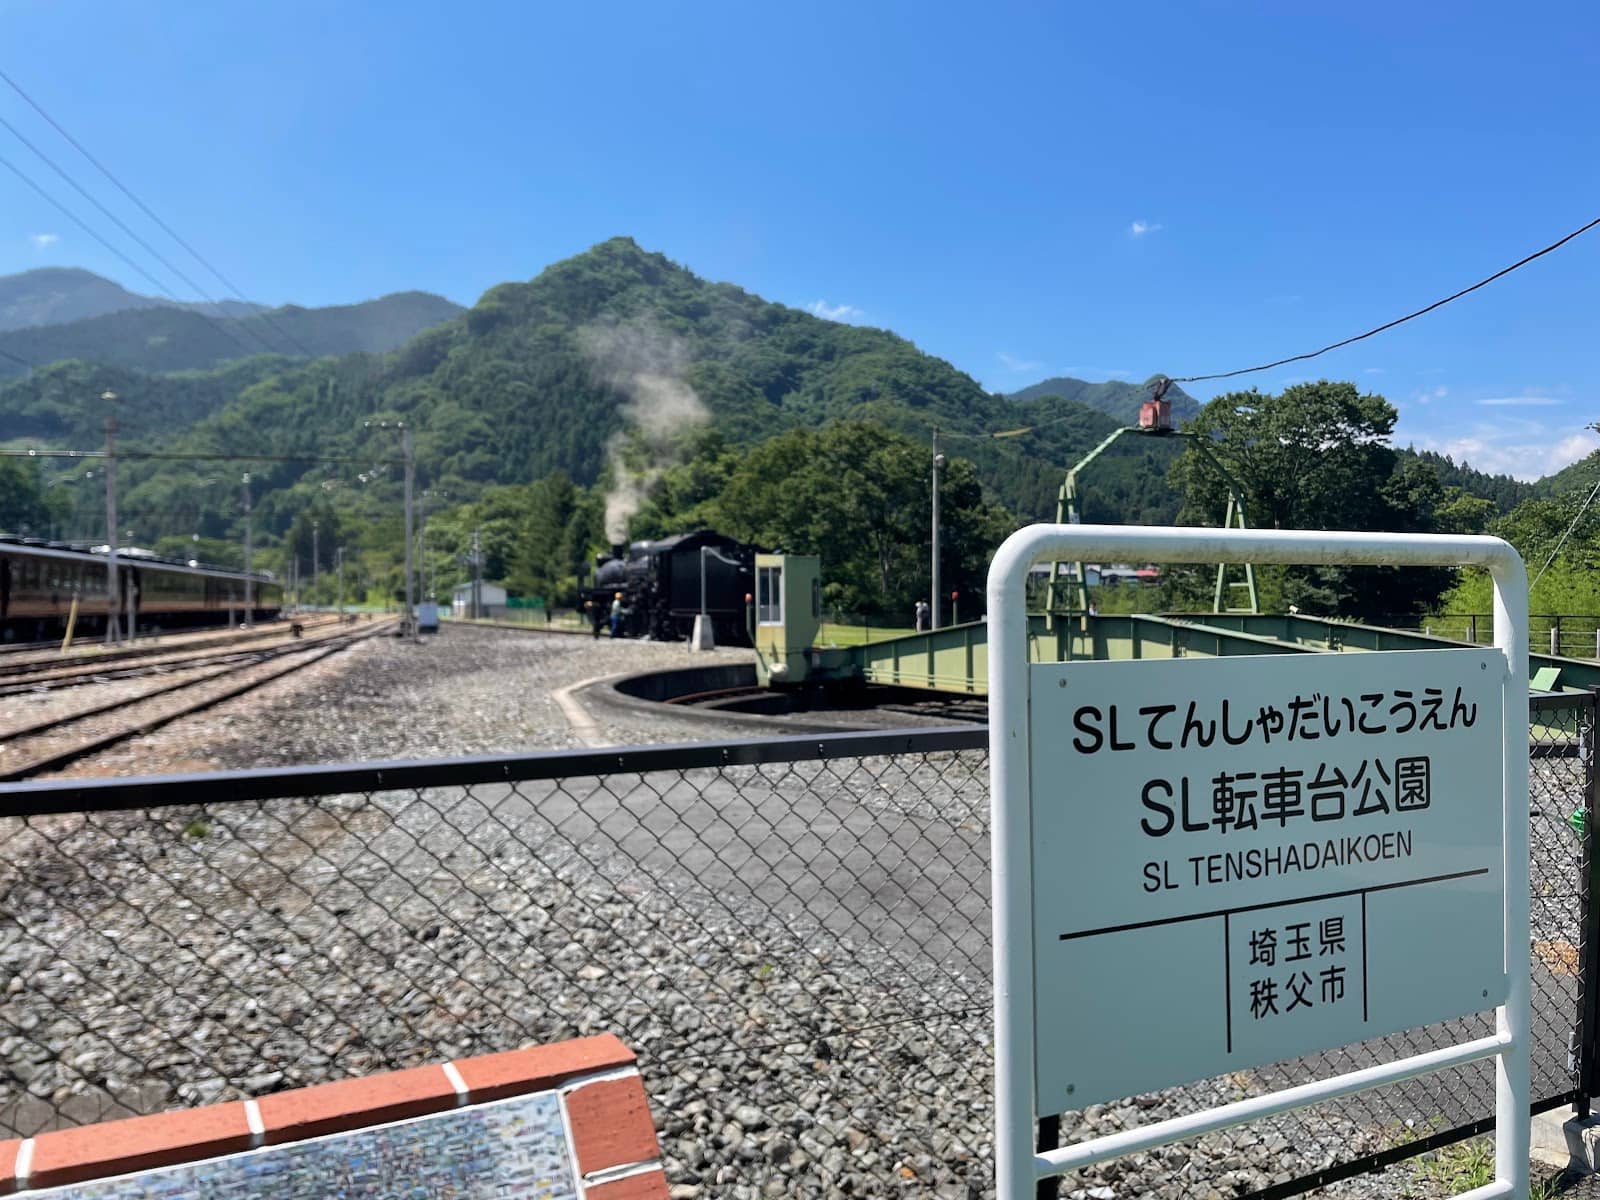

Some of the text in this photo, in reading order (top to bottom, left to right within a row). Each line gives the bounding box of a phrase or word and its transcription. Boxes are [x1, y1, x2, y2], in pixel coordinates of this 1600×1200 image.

[1072, 687, 1477, 754] SLてんしゃだいこうえん
[1140, 756, 1431, 837] SL転車台公園
[1143, 830, 1412, 893] SL TENSHADAIKOEN
[1249, 915, 1346, 967] 埼玉県
[1250, 965, 1346, 1020] 秩父市
